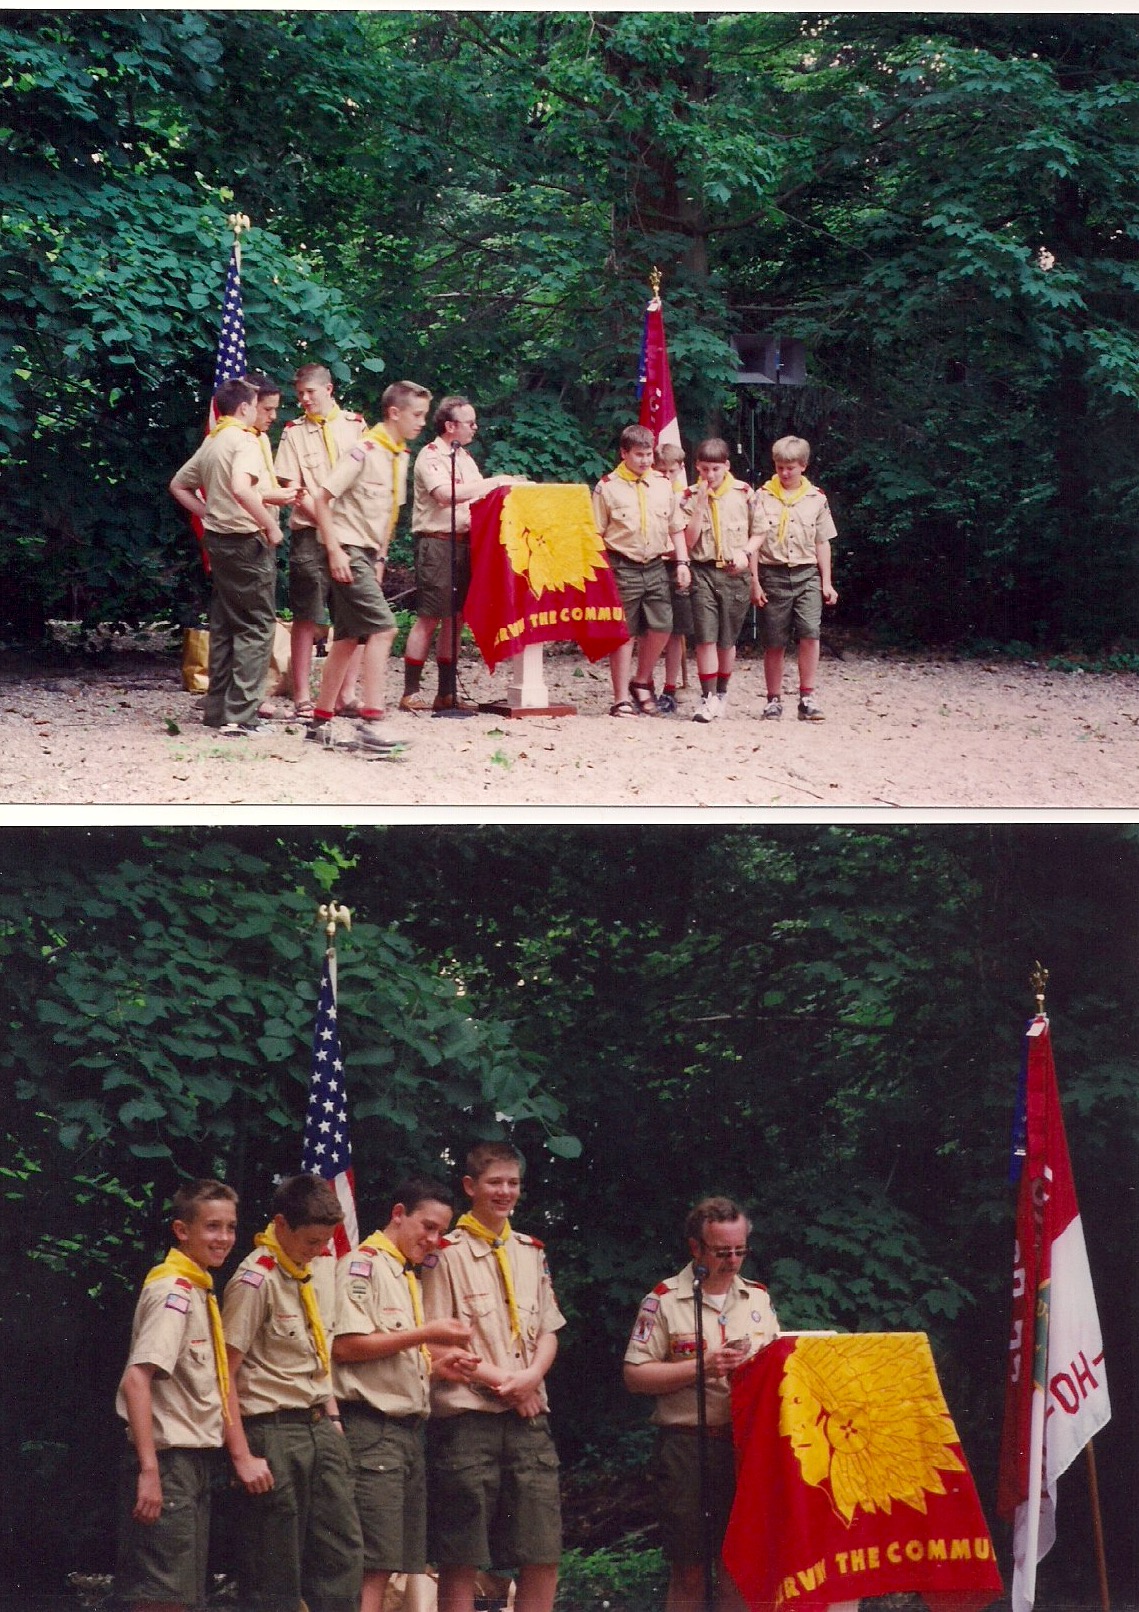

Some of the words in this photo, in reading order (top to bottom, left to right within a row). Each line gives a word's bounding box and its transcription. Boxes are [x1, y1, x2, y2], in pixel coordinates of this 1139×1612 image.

[530, 610, 557, 628] THE
[560, 606, 626, 622] COMMU
[835, 1547, 880, 1574] THE
[886, 1537, 997, 1563] COMMU
